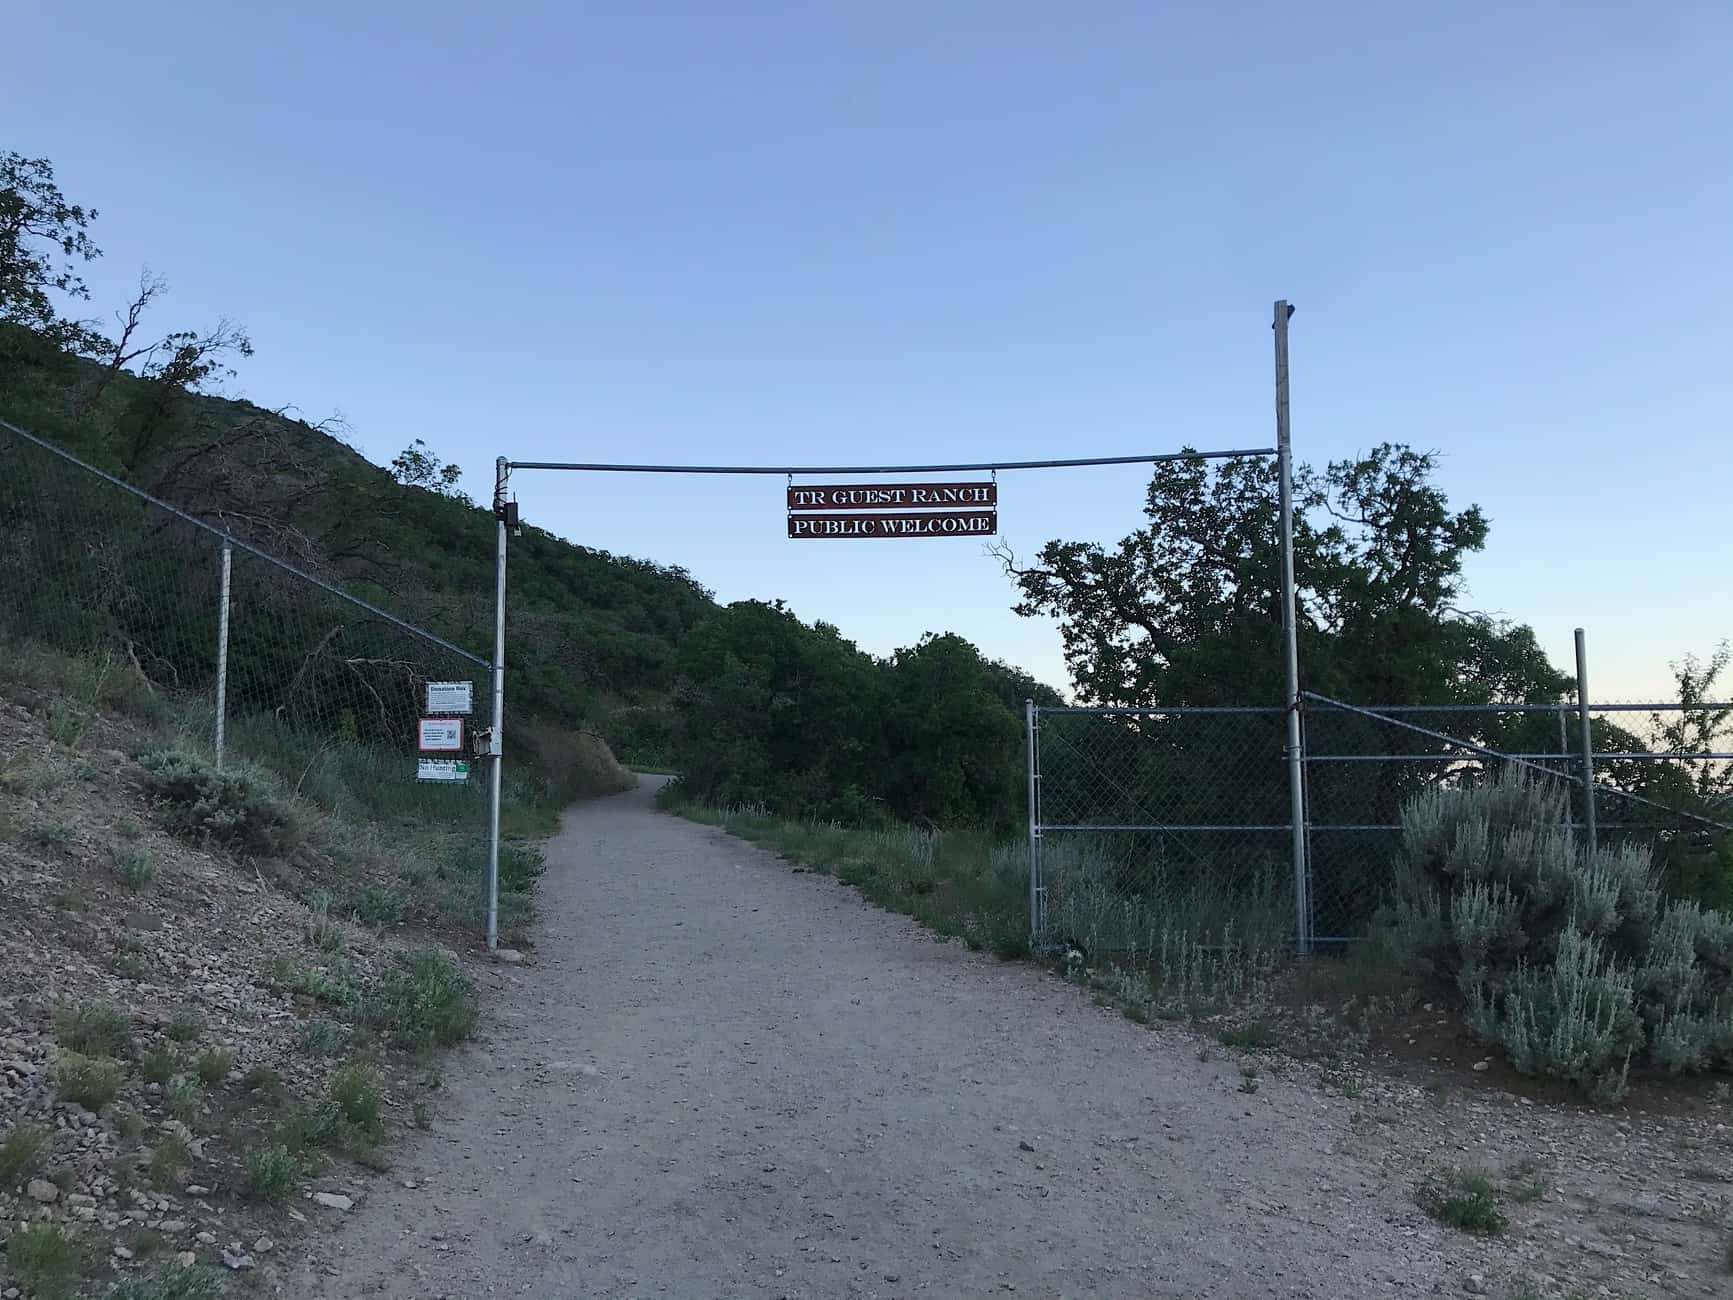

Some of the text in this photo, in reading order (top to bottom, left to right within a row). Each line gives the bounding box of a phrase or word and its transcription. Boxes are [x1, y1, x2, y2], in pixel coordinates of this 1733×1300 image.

[794, 488, 990, 505] TR GUEST RANCH
[794, 518, 990, 534] PUBLIC WELCOME
